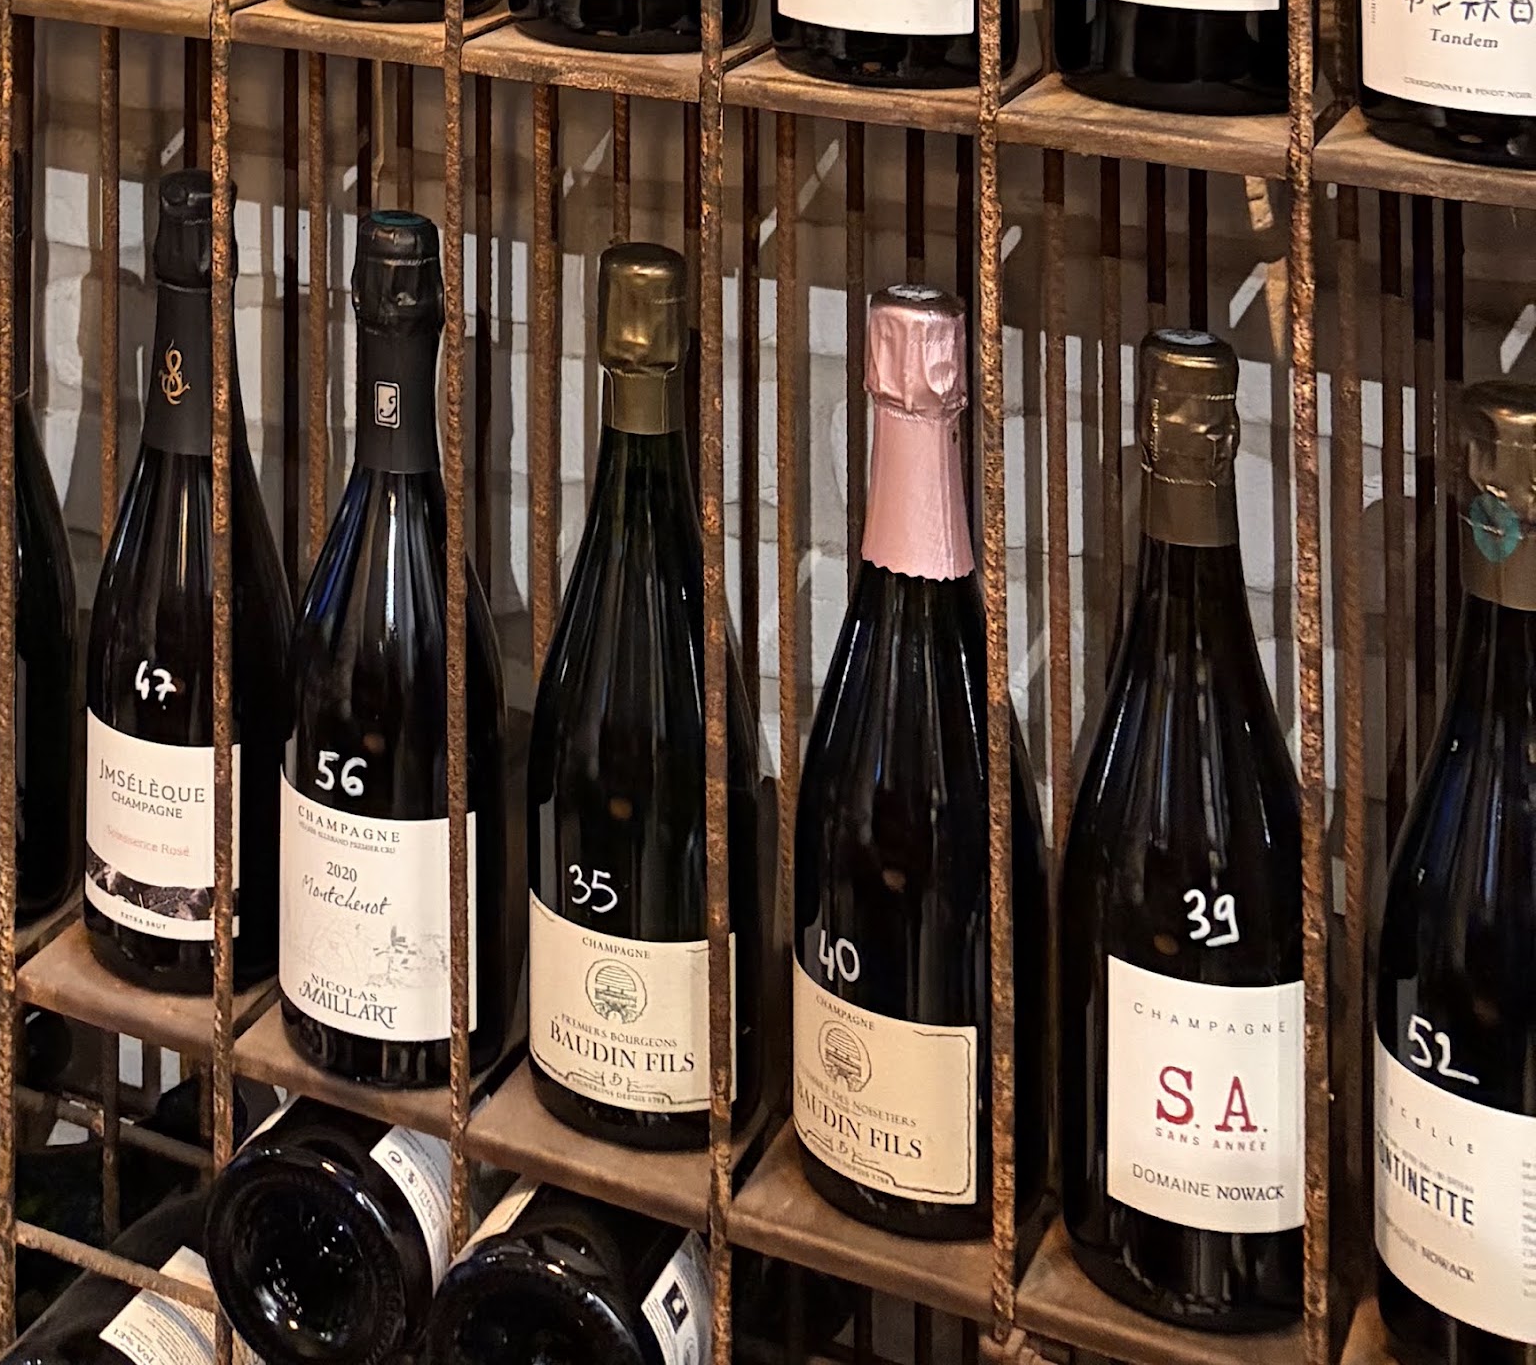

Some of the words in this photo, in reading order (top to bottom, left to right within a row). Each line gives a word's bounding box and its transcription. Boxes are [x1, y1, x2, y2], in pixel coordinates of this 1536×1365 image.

[1428, 27, 1499, 50] Tandem
[134, 659, 177, 703] 47
[314, 749, 369, 797] 56
[111, 790, 183, 820] CHAMPAGNE
[298, 804, 401, 843] CHAMPAGNE
[160, 841, 191, 858] Rosé
[380, 845, 396, 855] CRU
[326, 860, 358, 883] 2020
[568, 863, 619, 914] 35
[301, 873, 393, 916] Montchenot
[119, 910, 145, 925] EXTRA
[146, 920, 168, 931] BRUT
[1182, 888, 1241, 948] 39
[581, 935, 651, 960] CHAMPAGNE
[818, 929, 861, 983] 40
[298, 980, 399, 1030] MAILLART
[310, 972, 379, 1003] NICOLAS
[815, 992, 876, 1032] CHAMPAGNE
[1133, 1001, 1288, 1037] CHAMPAGNE
[549, 1019, 637, 1072] BAUDIN
[646, 1051, 695, 1075] FILS
[561, 1013, 608, 1040] PREMIERS
[610, 1032, 678, 1049] BOURGEONS
[852, 1097, 918, 1128] NOISETIERS
[869, 1127, 923, 1161] FILS
[1154, 1126, 1201, 1147] SANS
[1213, 1139, 1268, 1152] ANNÉE
[1132, 1162, 1212, 1199] DOMAINE
[1216, 1184, 1286, 1202] NOWACK
[1420, 1243, 1476, 1284] NOWACK
